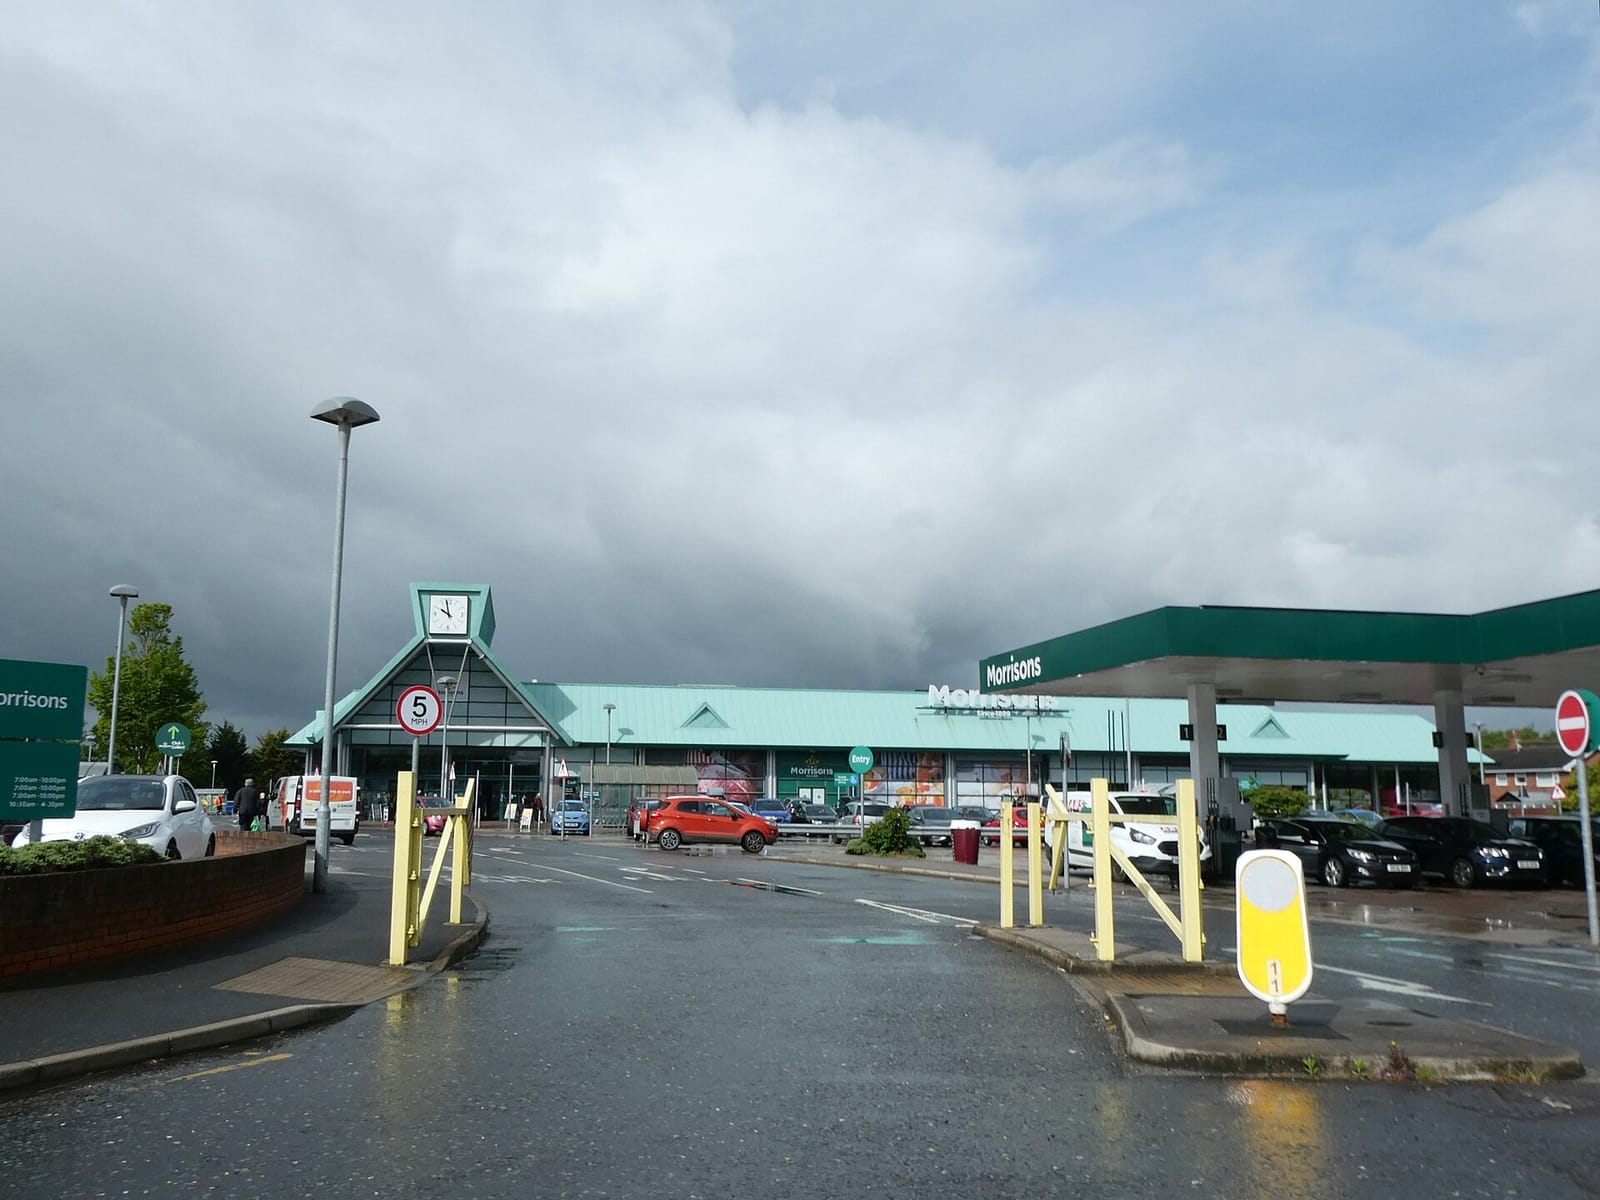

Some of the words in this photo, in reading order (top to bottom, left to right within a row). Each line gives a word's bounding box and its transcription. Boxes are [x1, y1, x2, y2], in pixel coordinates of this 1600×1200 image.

[987, 655, 1041, 687] Morrisons
[0, 690, 68, 709] orrisons
[412, 695, 428, 718] 5
[411, 718, 428, 726] MPH
[851, 755, 871, 765] Entry
[790, 765, 834, 776] Morrisons
